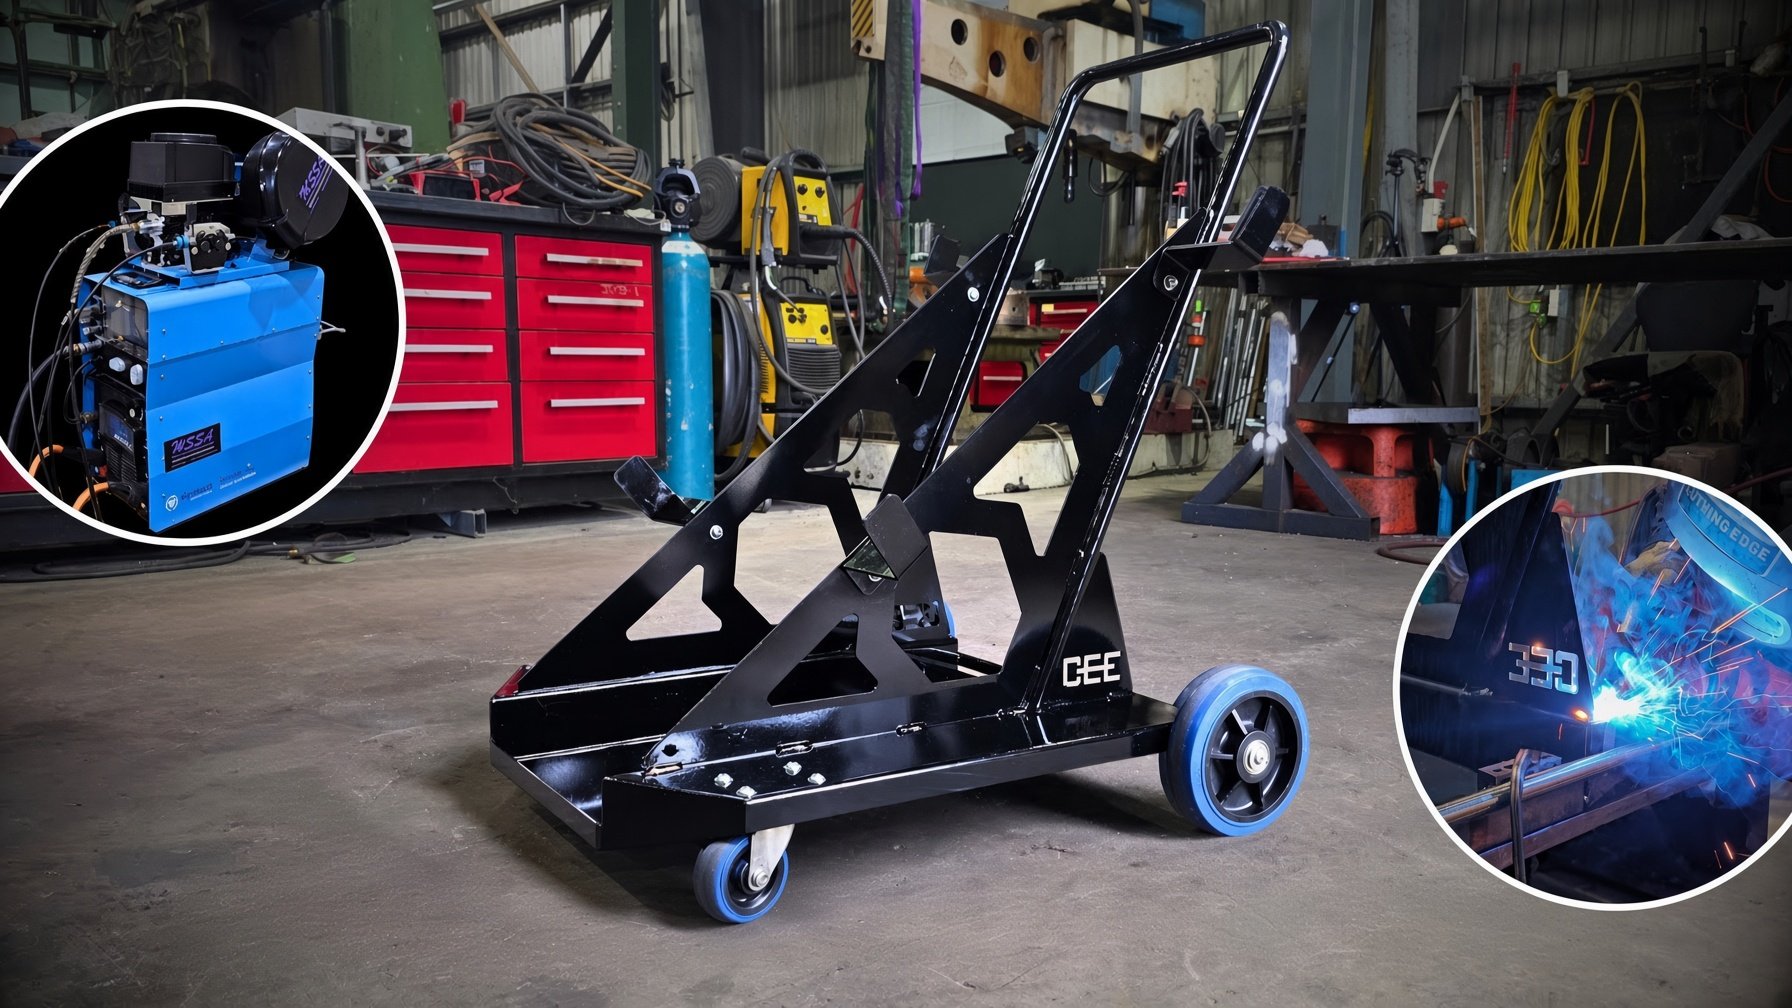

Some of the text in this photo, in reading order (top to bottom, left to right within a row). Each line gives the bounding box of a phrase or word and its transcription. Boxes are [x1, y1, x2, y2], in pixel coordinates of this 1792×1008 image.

[171, 428, 214, 454] WSSA
[1728, 526, 1771, 562] EDGE
[1062, 650, 1121, 688] CEE
